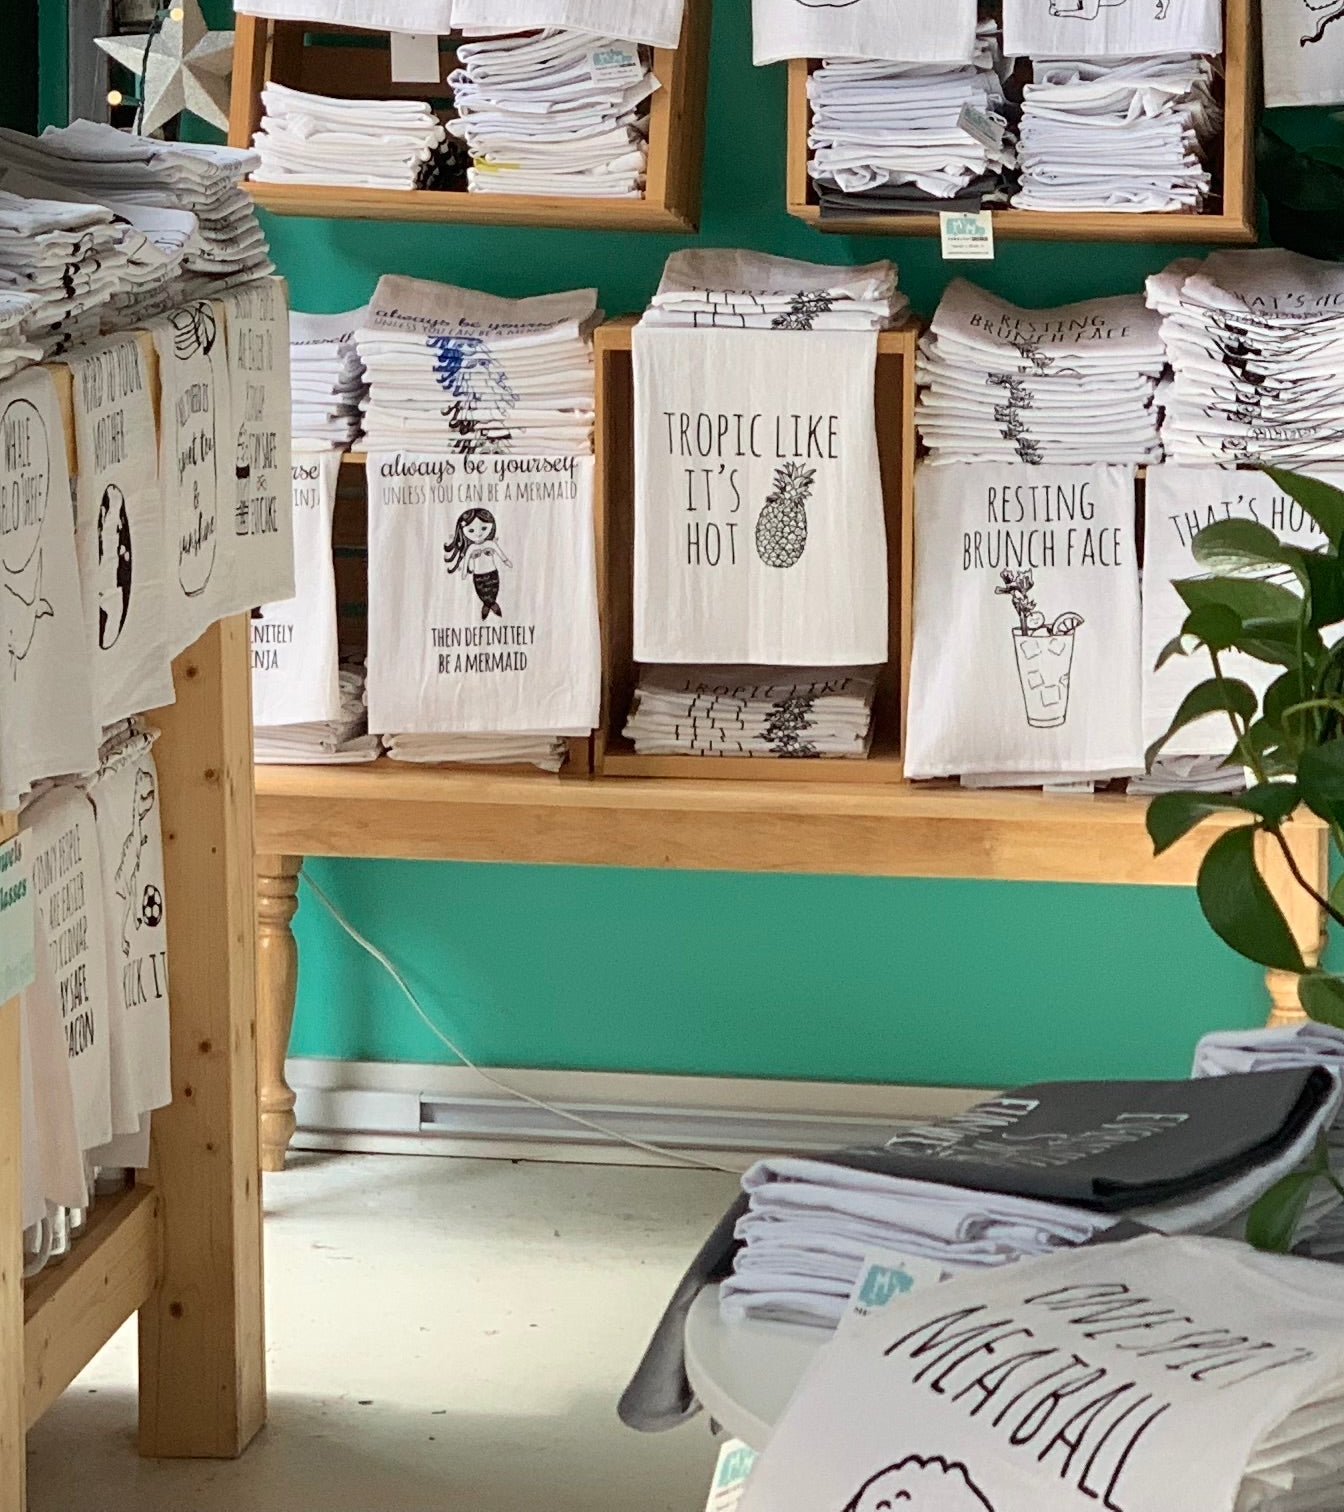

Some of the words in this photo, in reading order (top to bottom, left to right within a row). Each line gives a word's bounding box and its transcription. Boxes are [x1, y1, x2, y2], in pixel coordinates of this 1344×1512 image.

[662, 411, 763, 460] TROPIC
[775, 411, 839, 460] LIKE
[380, 453, 456, 484] always
[463, 455, 488, 475] be
[493, 455, 578, 482] yourself
[685, 462, 740, 513] IT'S
[382, 486, 426, 506] UNLESS
[430, 485, 453, 504] YOU
[457, 484, 484, 503] CAN
[487, 484, 500, 503] BE
[504, 483, 512, 501] A
[514, 480, 577, 501] MERMAID
[986, 481, 1095, 525] RESTING
[686, 520, 737, 568] HOT
[963, 525, 1054, 571] BRUNCH
[1066, 525, 1123, 567] FACE
[431, 625, 461, 650] THEN
[463, 624, 536, 648] DEFINITELY
[438, 651, 453, 674] BE
[455, 652, 462, 674] A
[463, 651, 528, 673] MERMAID
[882, 1303, 1173, 1512] MEATBALL
